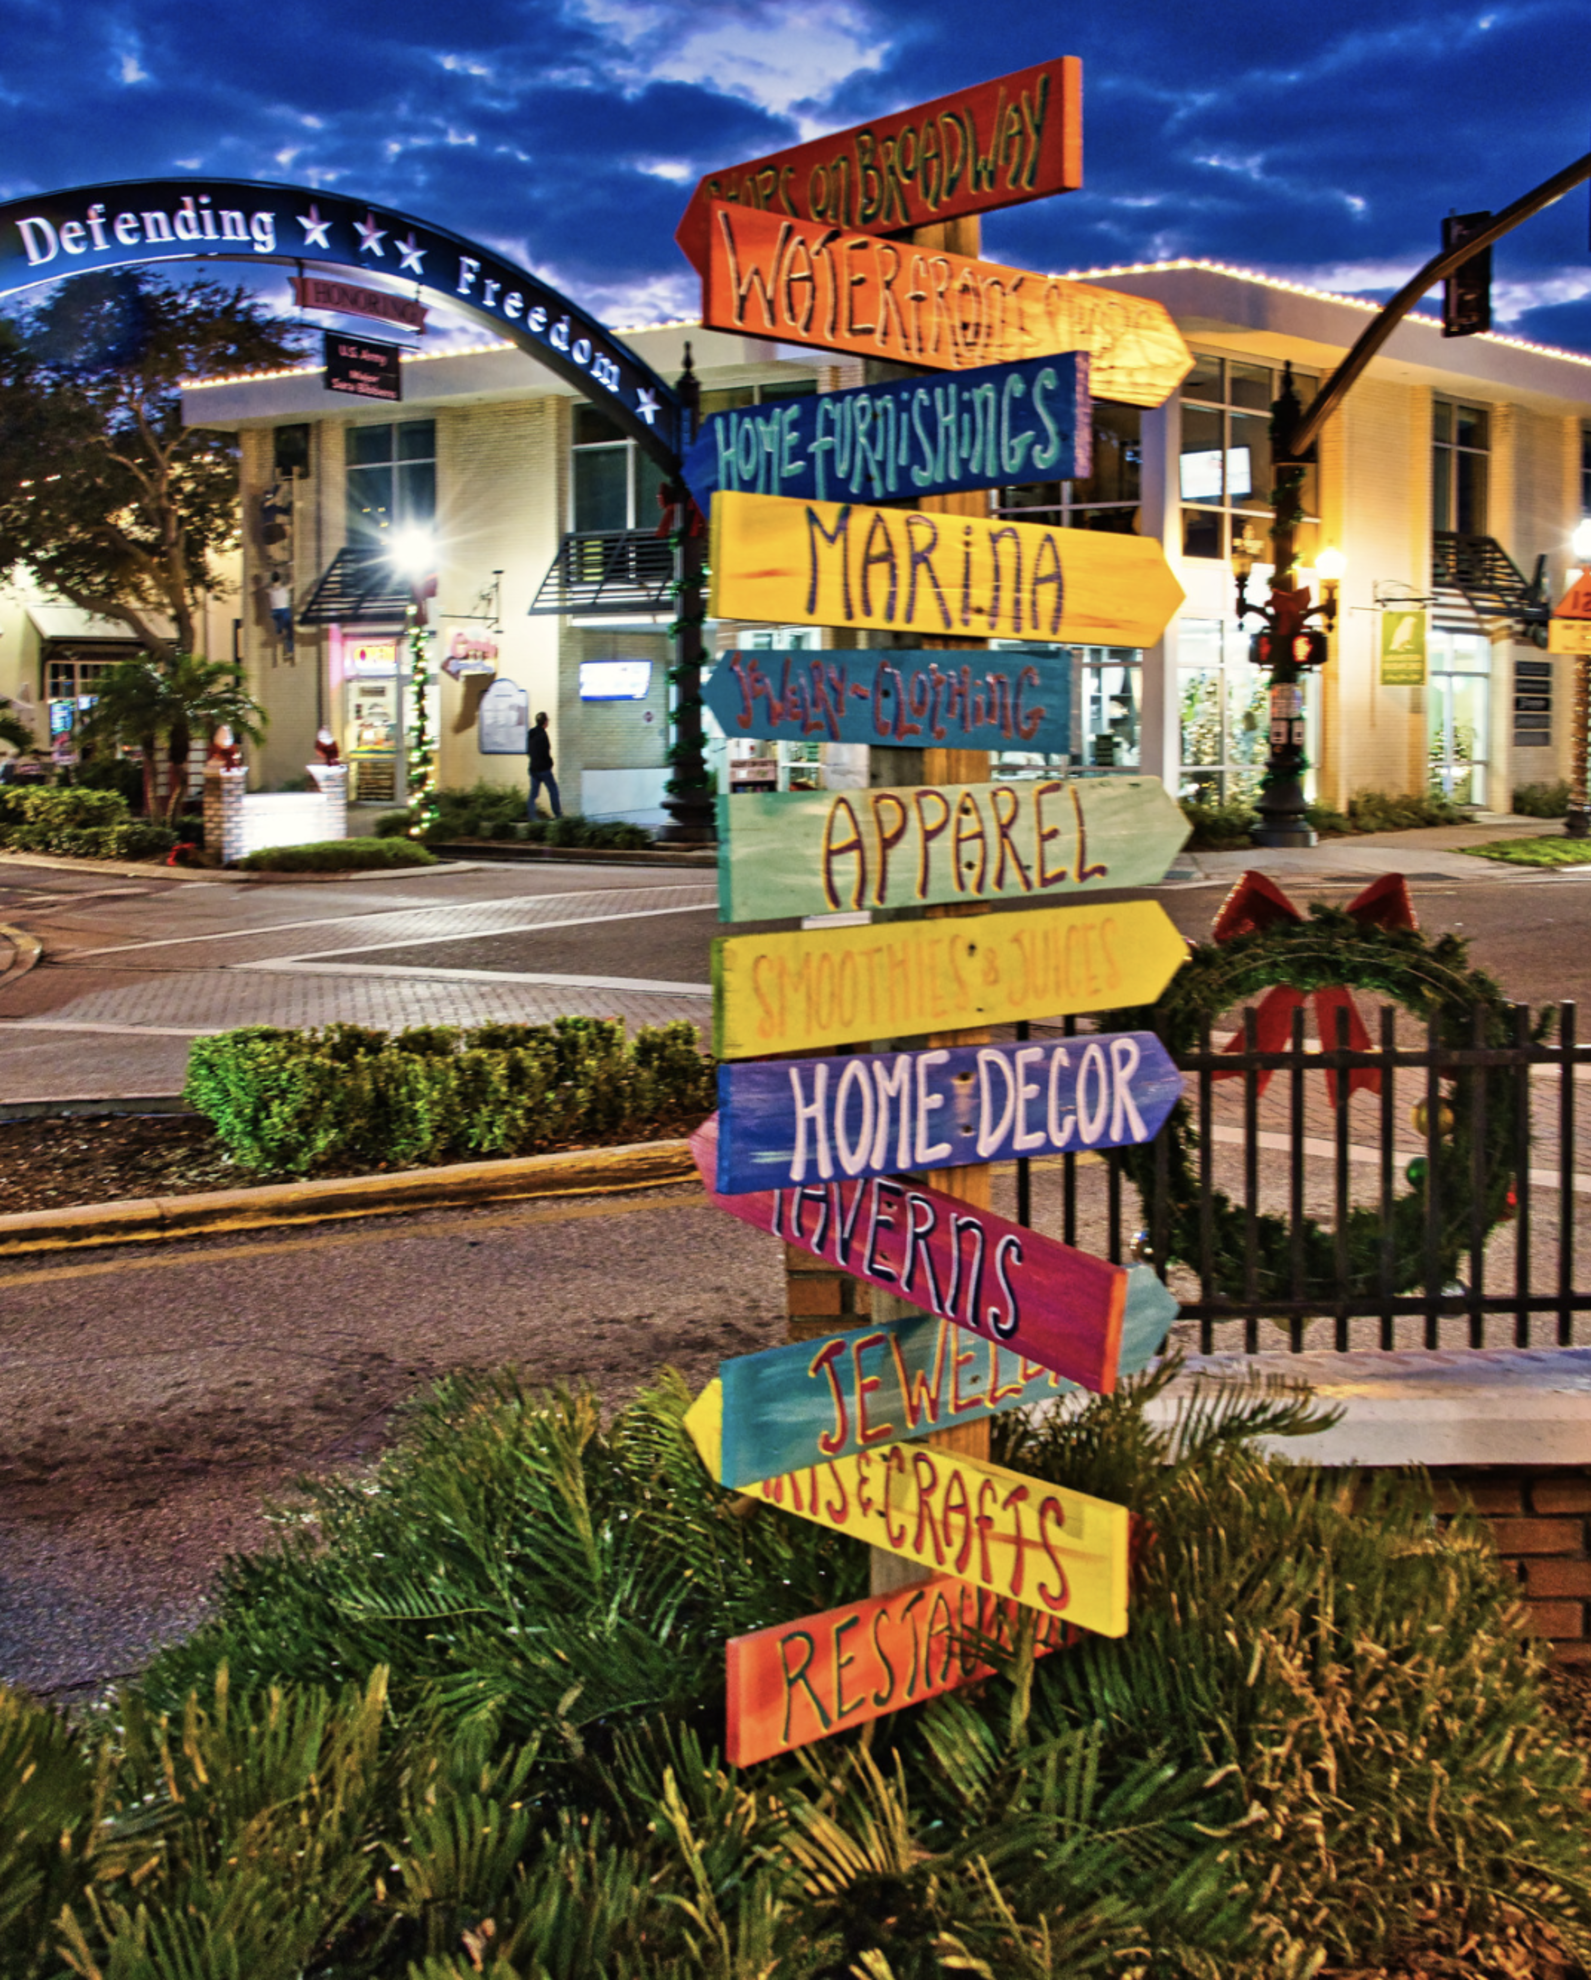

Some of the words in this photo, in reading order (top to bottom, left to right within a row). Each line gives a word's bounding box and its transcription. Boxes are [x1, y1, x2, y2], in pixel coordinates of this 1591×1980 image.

[854, 73, 1051, 227] BROADWAY
[15, 195, 277, 267] Defending
[456, 256, 622, 393] Freedom
[313, 281, 419, 324] HONORING
[714, 404, 807, 495] HOME
[821, 780, 1108, 911] APPAREL
[752, 933, 972, 1039] SMOOTHIES
[1007, 917, 1122, 1007] JUICES
[789, 1049, 953, 1182] HOME
[975, 1037, 1149, 1158] DECOR
